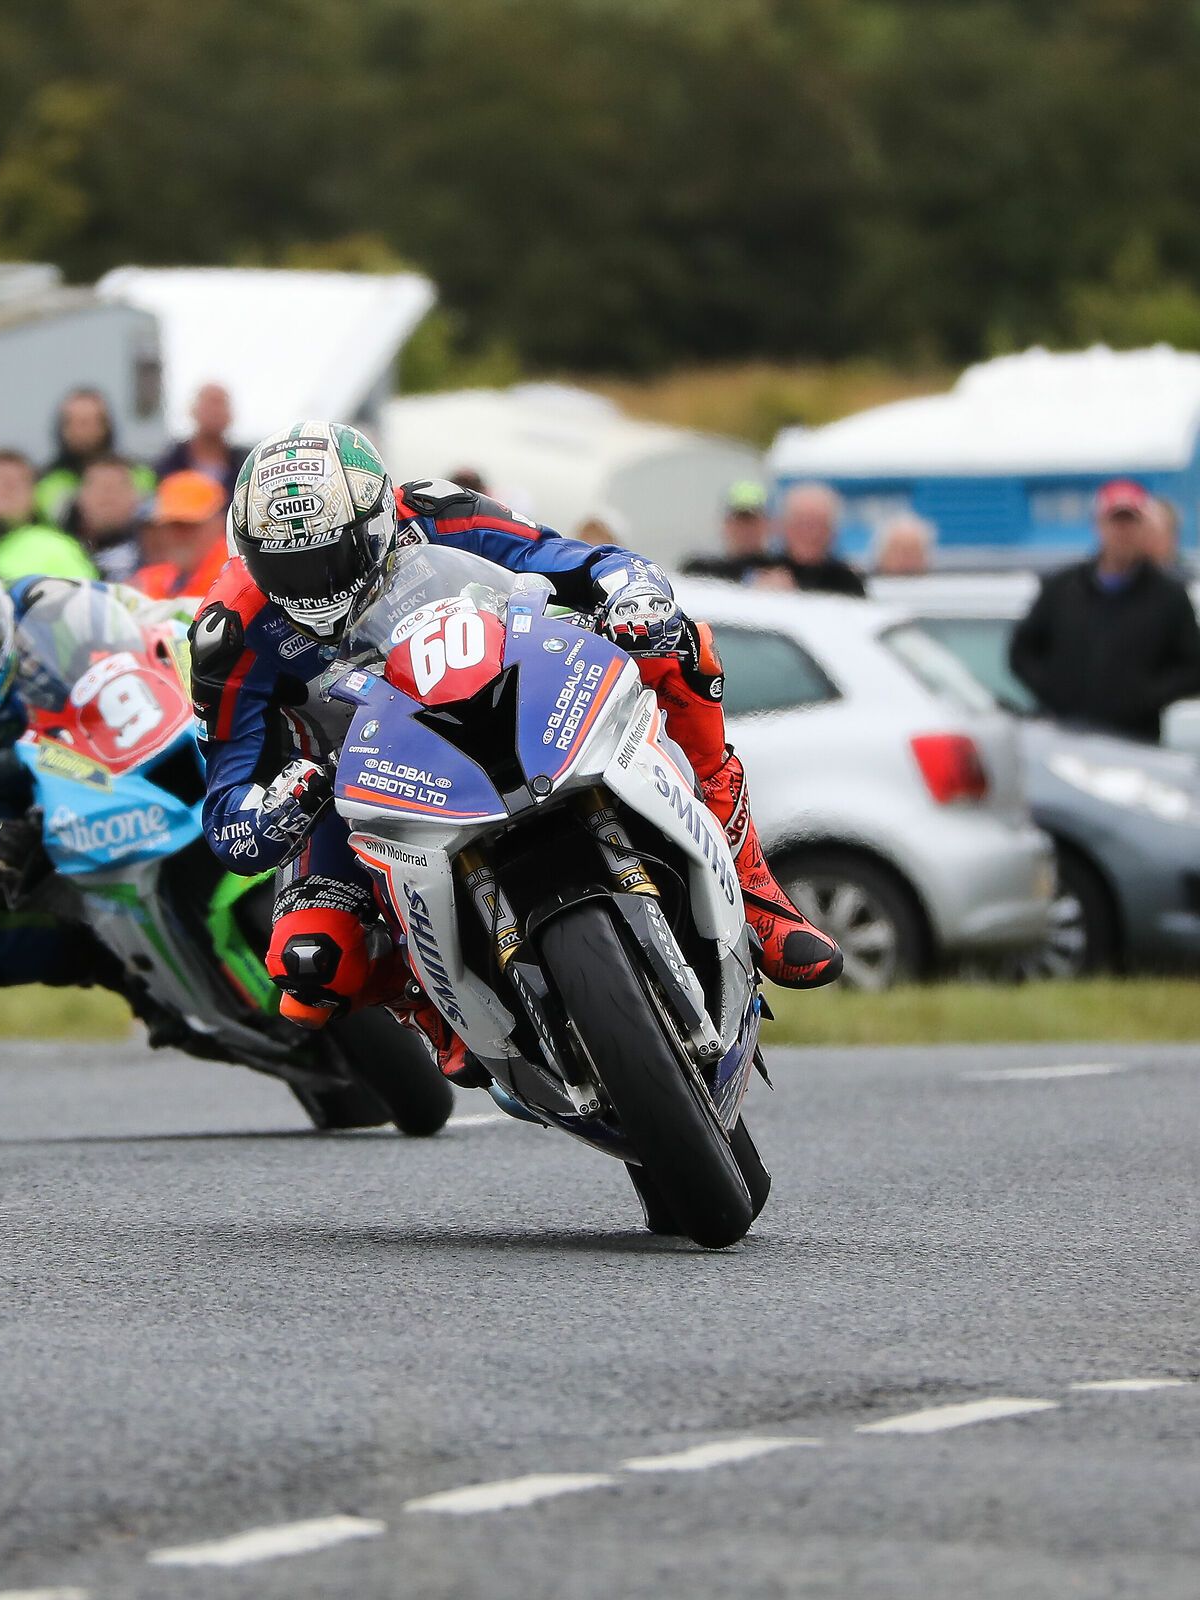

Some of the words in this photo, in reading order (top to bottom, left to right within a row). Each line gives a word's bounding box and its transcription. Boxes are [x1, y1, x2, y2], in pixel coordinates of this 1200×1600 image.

[275, 440, 315, 453] SMART
[261, 461, 319, 480] BRIGGS
[275, 497, 315, 517] SHOEI
[261, 537, 310, 550] NOLAN
[310, 527, 343, 546] OILS
[387, 589, 428, 623] HICKY
[396, 612, 425, 639] mce
[409, 612, 486, 697] 60
[565, 638, 586, 667] COTSWOLD
[97, 673, 164, 748] 9
[547, 674, 581, 730] GLOBAL
[556, 688, 592, 751] ROBOTS
[583, 664, 604, 690] LTD
[348, 745, 380, 754] COTSWOLD
[617, 739, 637, 770] BMW
[629, 706, 651, 746] Motorrad
[377, 760, 436, 786] GLOBAL
[357, 771, 418, 798] ROBOTS
[417, 790, 448, 806] LTD
[229, 835, 259, 860] Racing
[652, 764, 739, 907] SMITHS
[387, 845, 428, 868] Motorrad
[620, 872, 645, 888] TTX
[497, 931, 521, 949] TTX
[403, 882, 469, 1031] SMITHS
